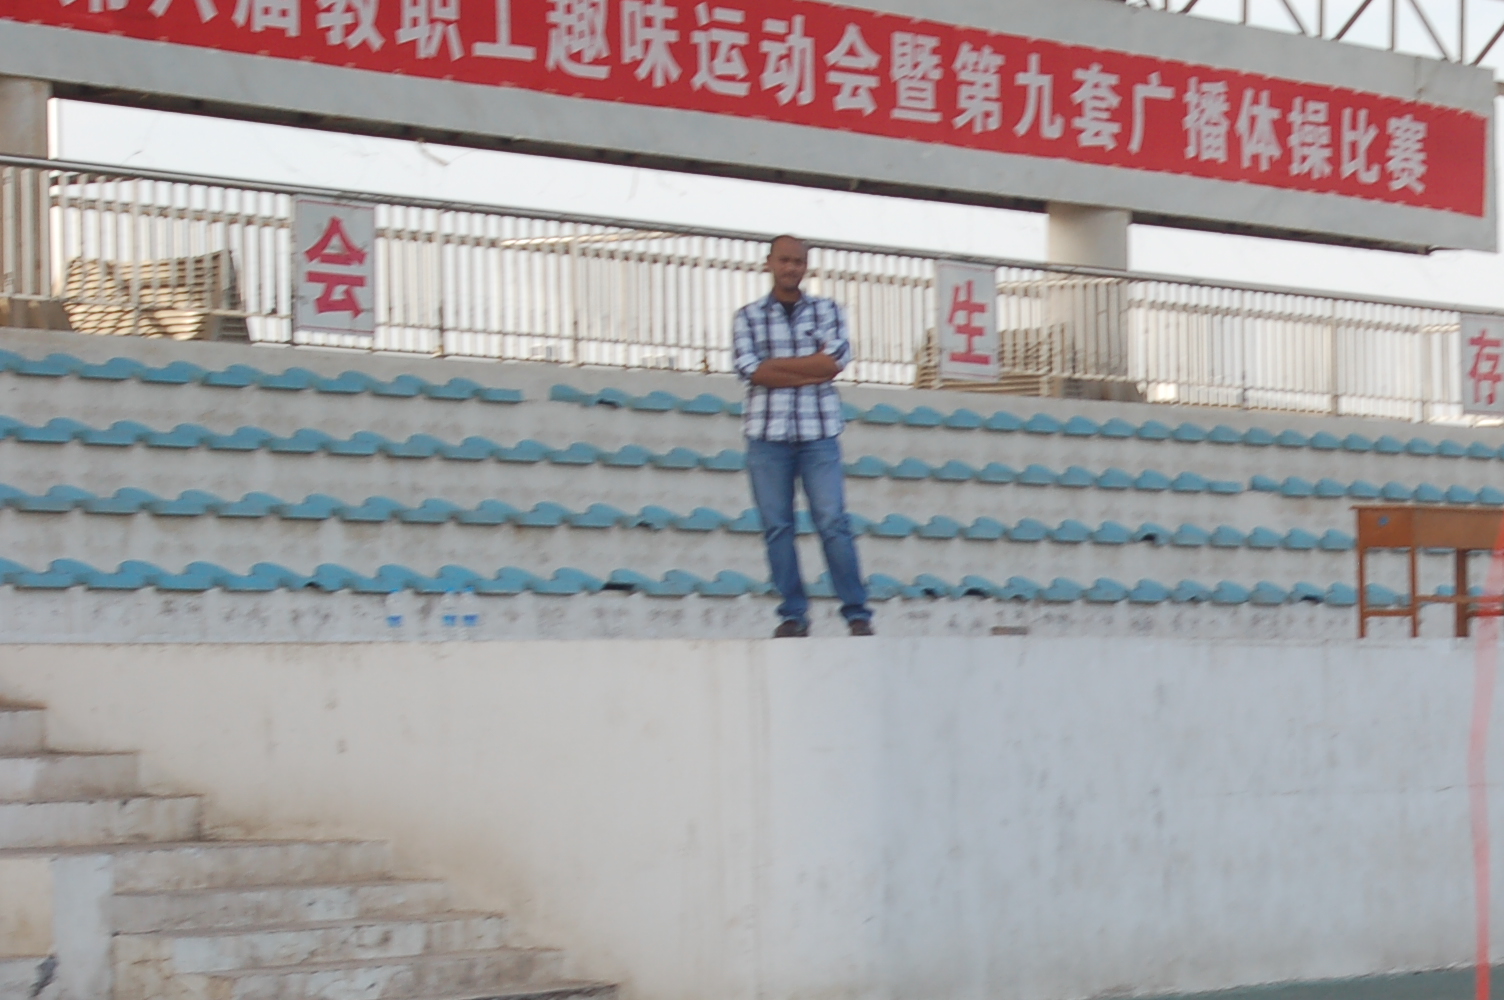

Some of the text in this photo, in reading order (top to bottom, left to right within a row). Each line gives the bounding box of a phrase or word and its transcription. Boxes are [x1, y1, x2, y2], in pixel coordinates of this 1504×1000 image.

[58, 0, 1429, 195] 教职工趣味运动会暨第九套广播体操比赛
[304, 216, 367, 318] 会
[947, 279, 991, 365] 生
[1468, 328, 1504, 404] 存
